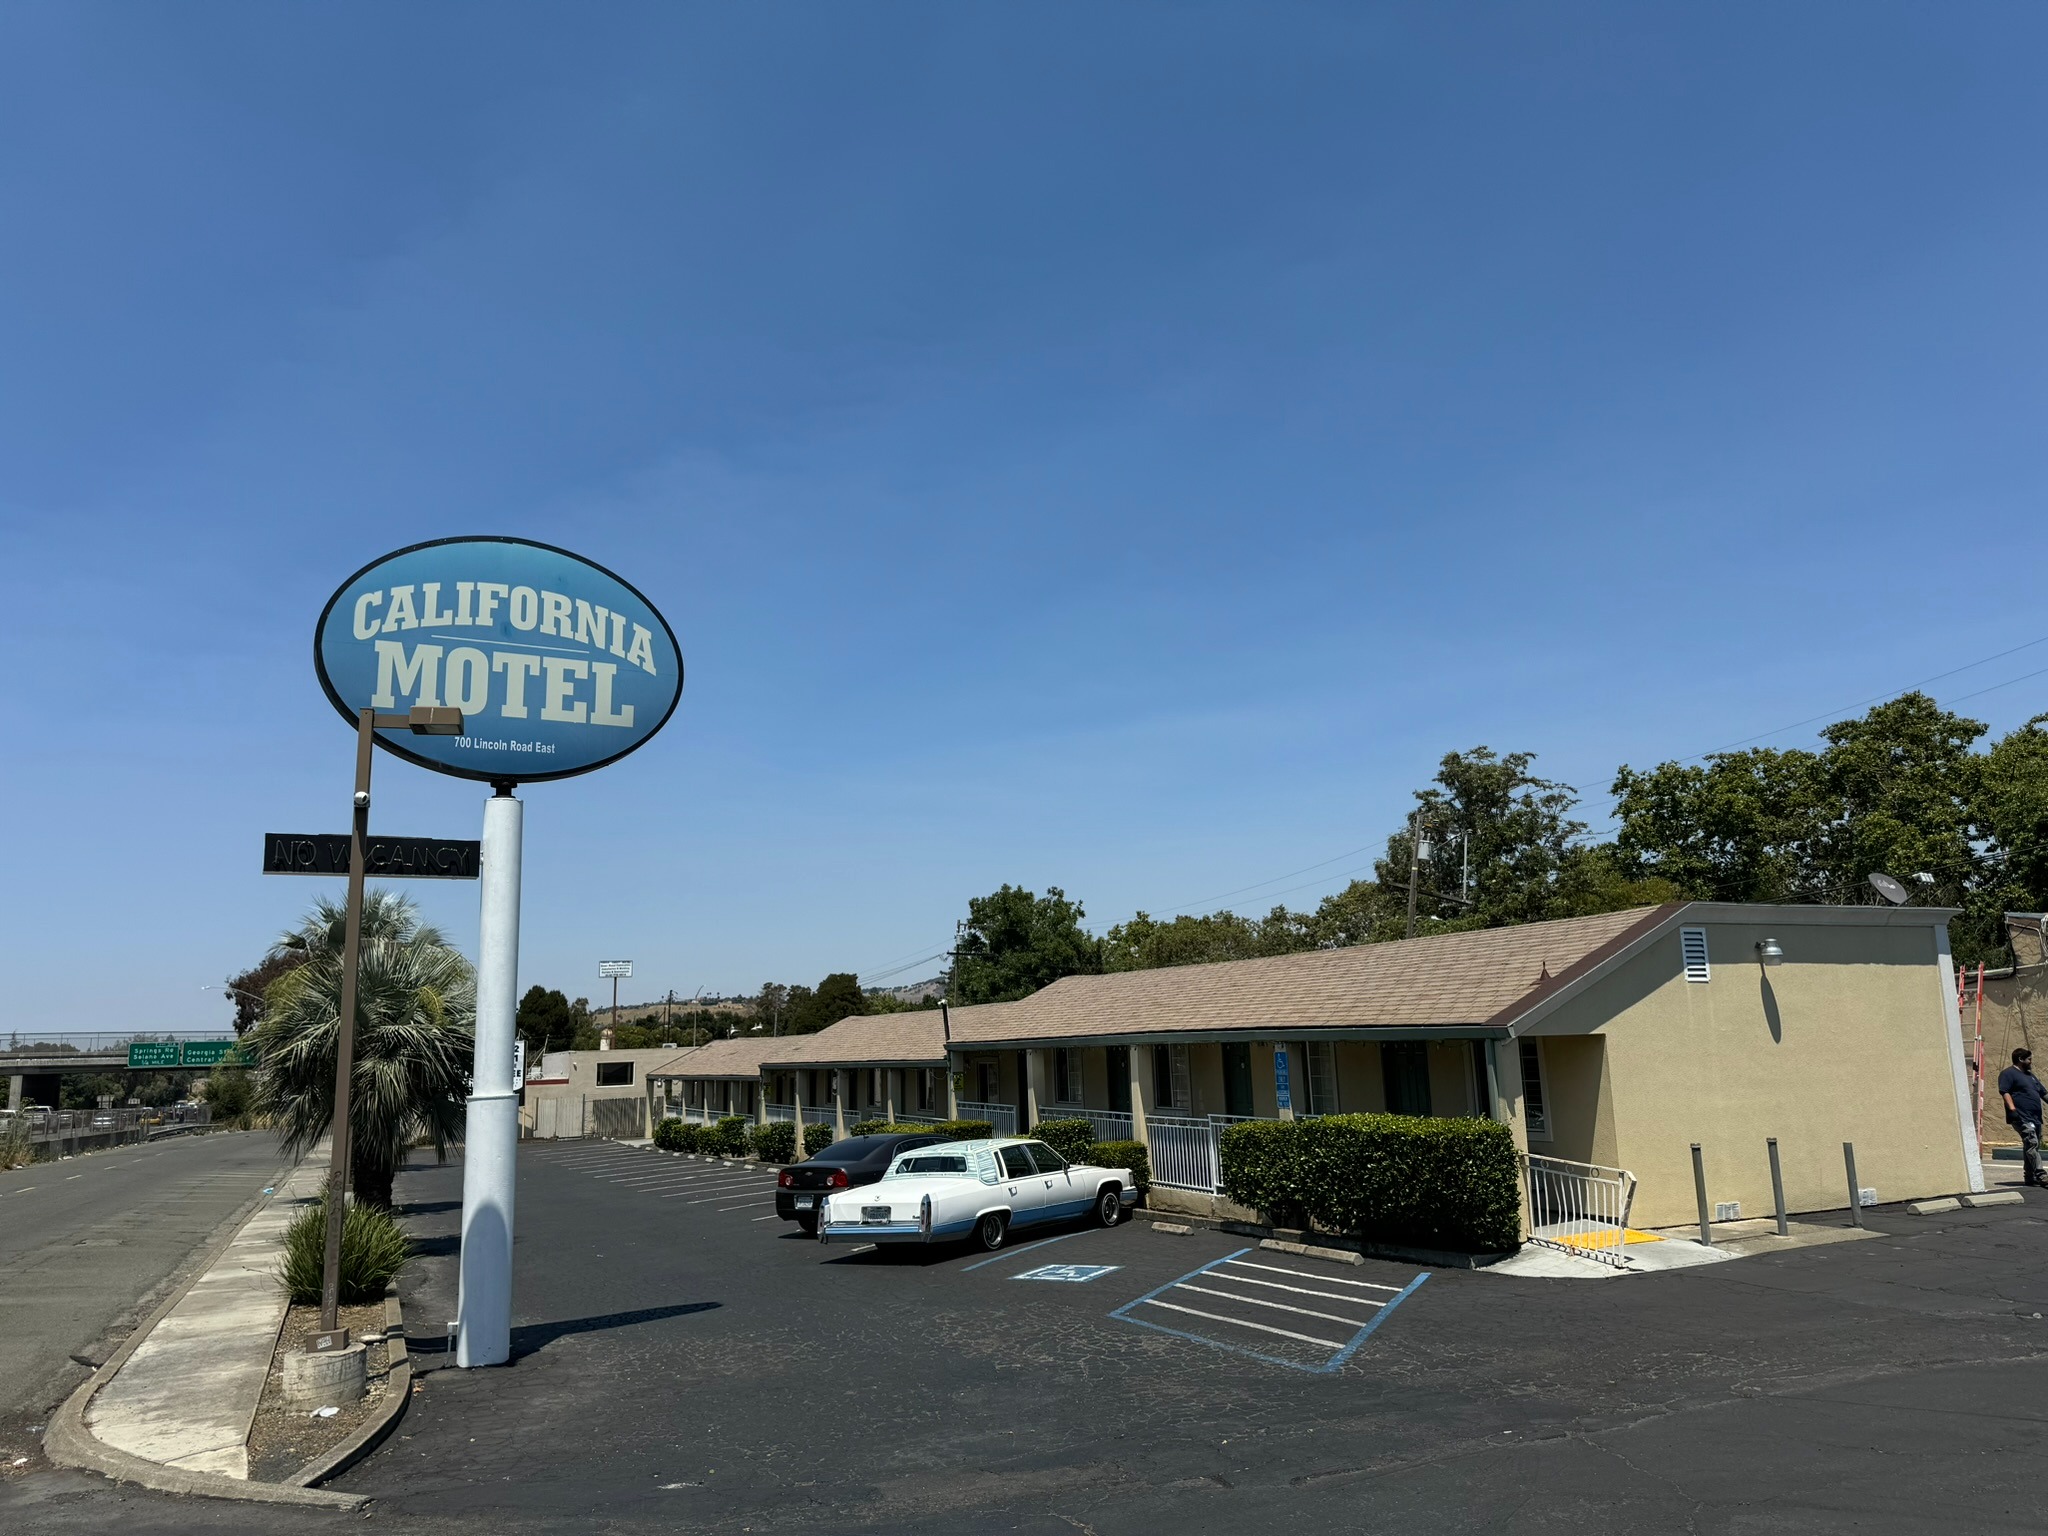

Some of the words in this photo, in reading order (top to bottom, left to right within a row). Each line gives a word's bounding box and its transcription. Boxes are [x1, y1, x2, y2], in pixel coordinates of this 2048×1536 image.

[353, 582, 657, 676] CALIFORNIA
[371, 640, 635, 728] MOTEL
[454, 736, 472, 748] 700
[474, 738, 507, 751] Lincoln
[510, 740, 533, 752] Road
[536, 741, 556, 754] East
[273, 839, 318, 866] NO
[329, 842, 470, 868] VCANCY
